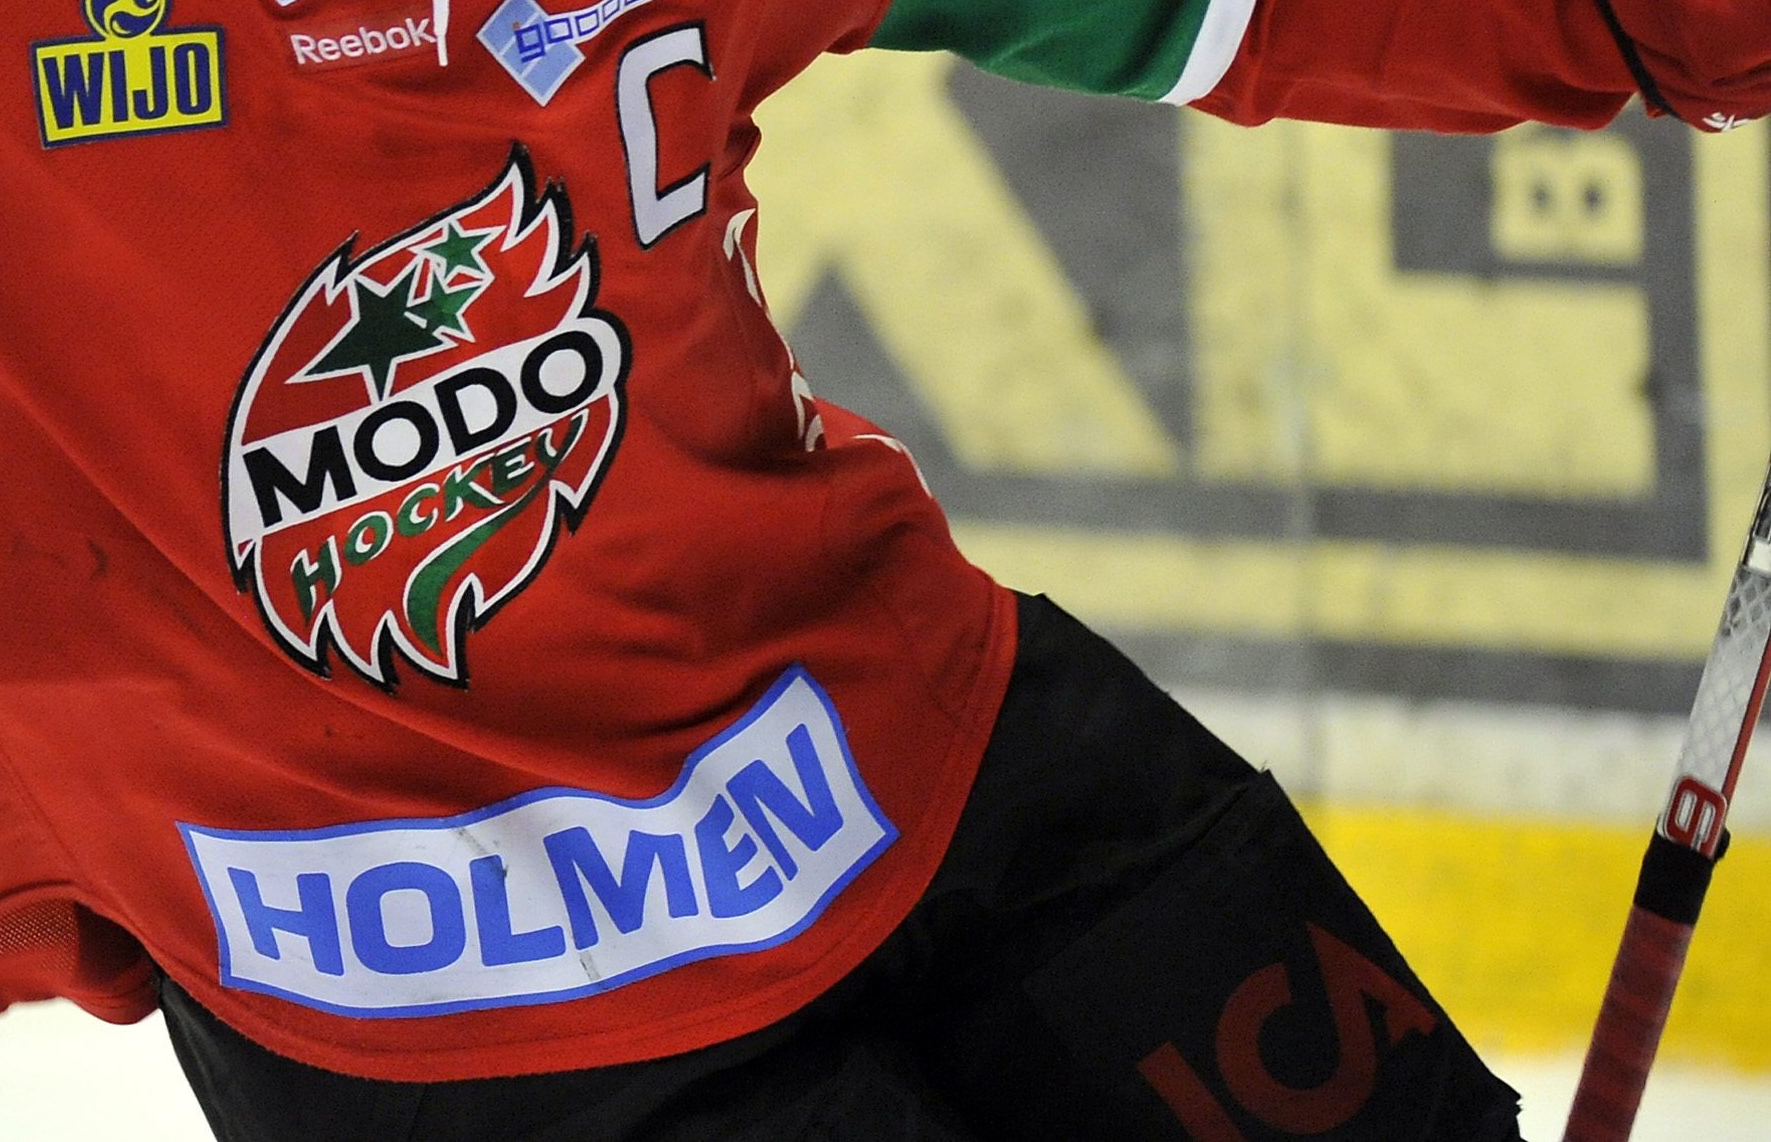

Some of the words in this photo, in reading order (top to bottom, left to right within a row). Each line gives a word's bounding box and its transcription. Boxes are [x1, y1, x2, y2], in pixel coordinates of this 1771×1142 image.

[42, 42, 215, 131] WIJO
[290, 17, 437, 65] Reebok
[614, 20, 716, 251] C
[242, 329, 605, 529] MODO
[290, 408, 589, 628] HOCKEY
[227, 723, 846, 978] HOLMEN
